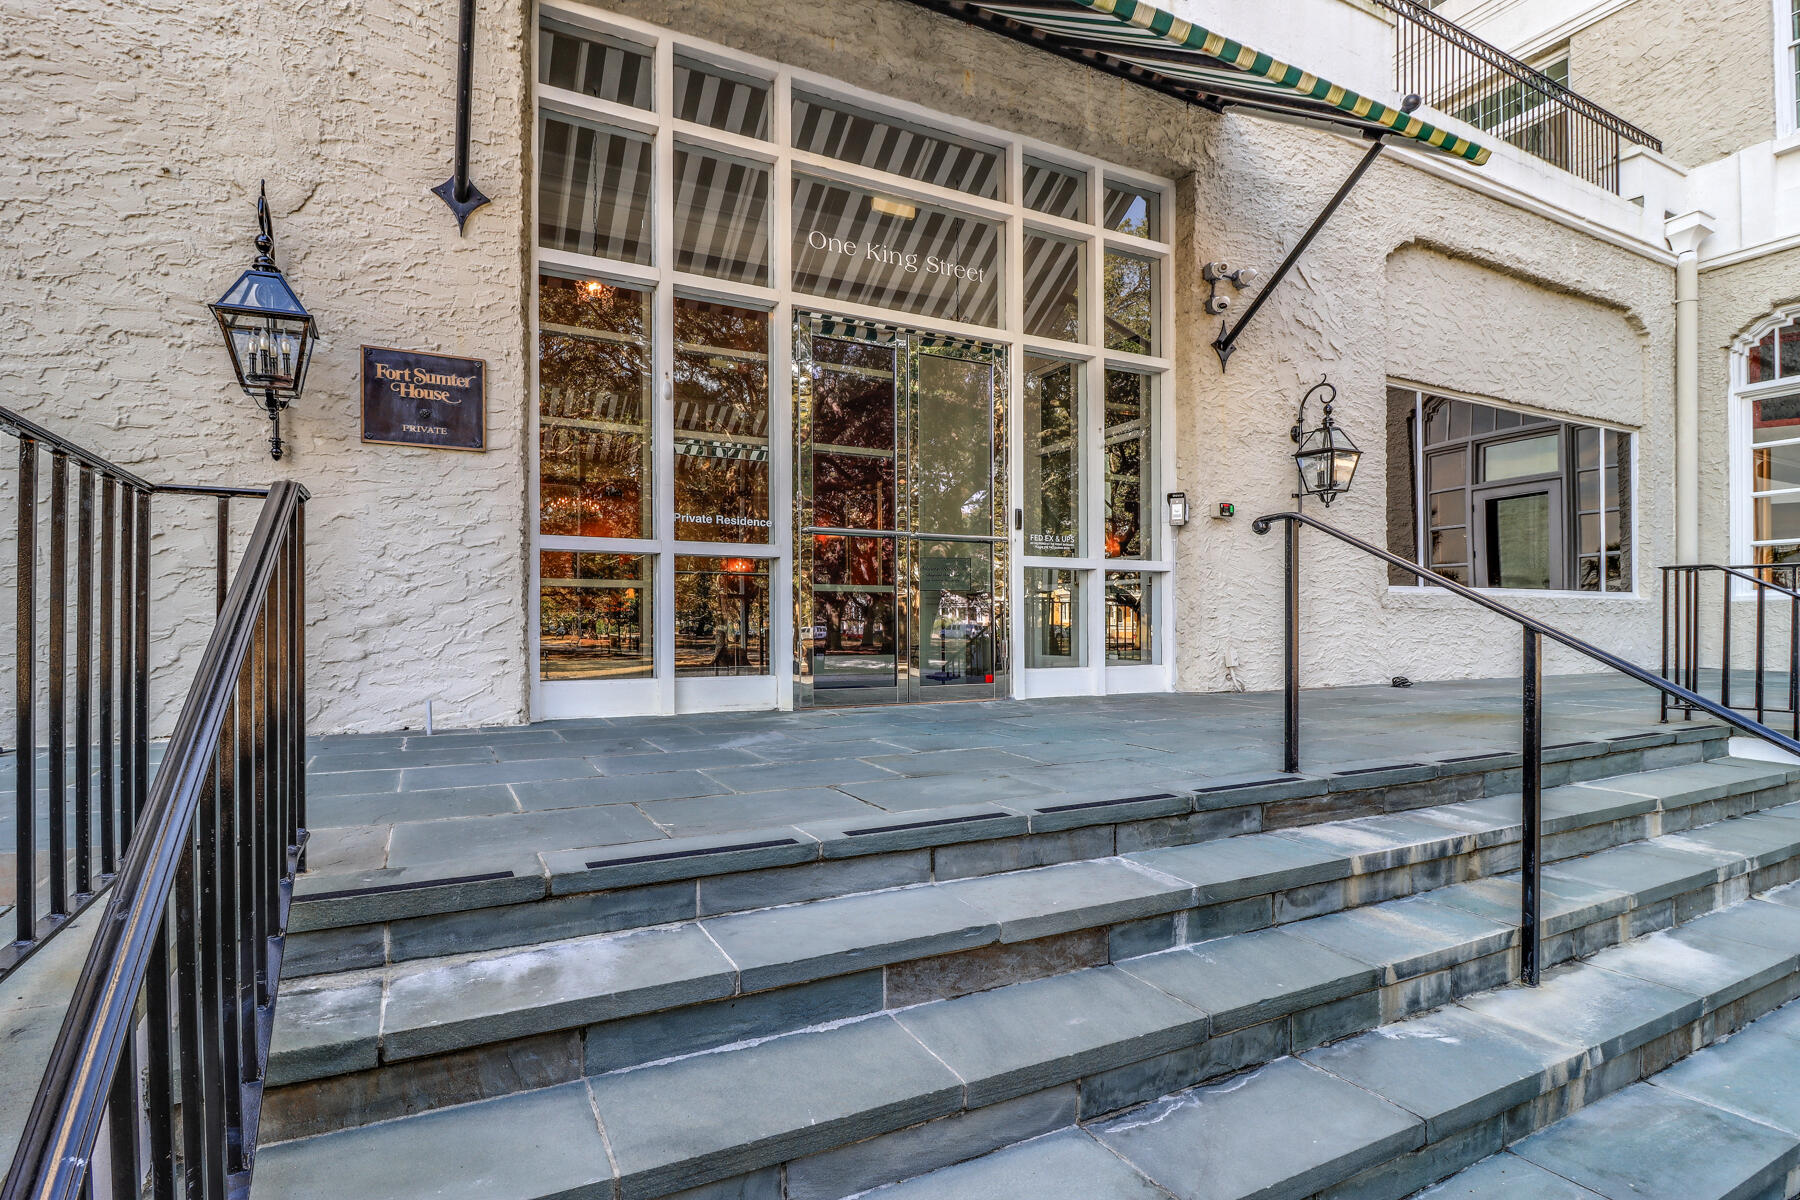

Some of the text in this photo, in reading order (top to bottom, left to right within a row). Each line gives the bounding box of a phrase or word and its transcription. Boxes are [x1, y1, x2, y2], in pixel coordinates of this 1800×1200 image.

[808, 231, 984, 283] One King Street
[375, 363, 477, 389] Fort Sumter
[390, 382, 462, 404] House
[402, 424, 448, 435] PRIVATE
[674, 512, 773, 528] Private Residence
[1055, 535, 1060, 543] &
[1061, 534, 1075, 543] UPS
